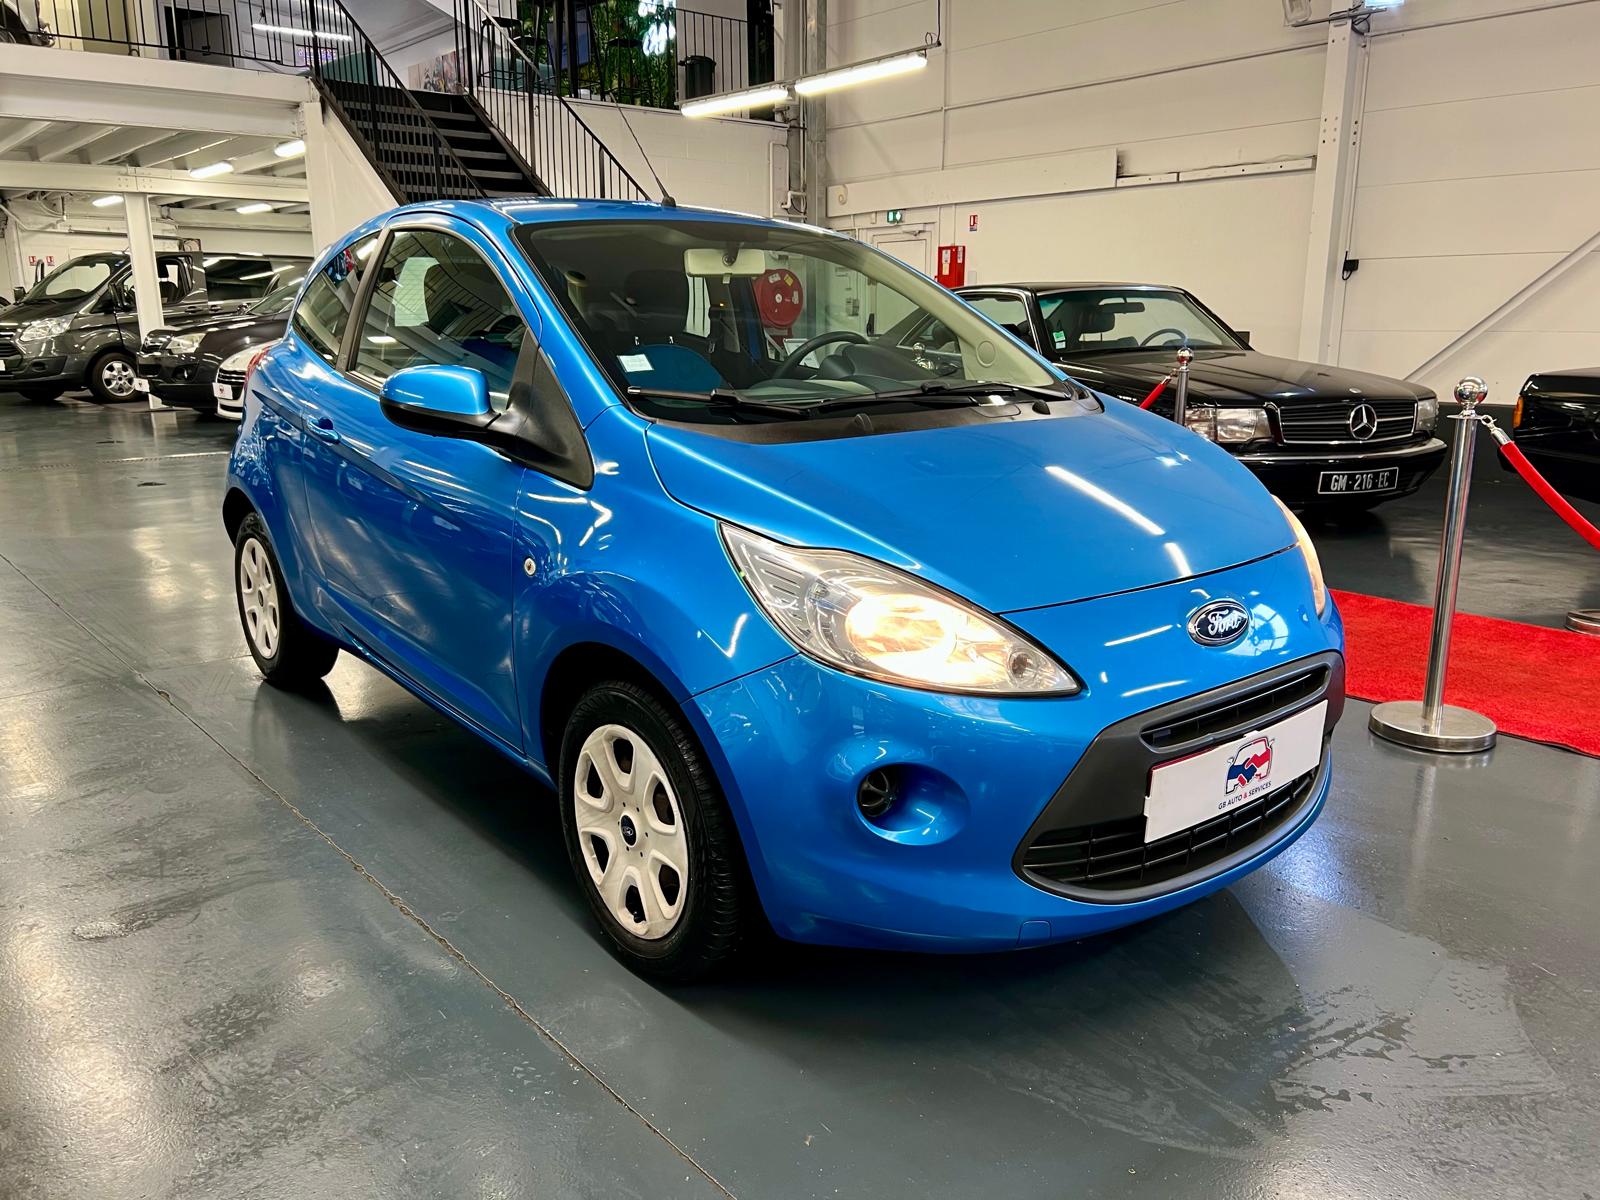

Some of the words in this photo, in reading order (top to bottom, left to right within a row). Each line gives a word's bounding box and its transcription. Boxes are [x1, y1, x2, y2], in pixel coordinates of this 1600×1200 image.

[1330, 475, 1348, 491] GM
[1353, 473, 1373, 490] 216
[1377, 471, 1390, 488] EC
[1207, 608, 1248, 636] Ford
[1218, 801, 1227, 810] GB
[1227, 794, 1243, 806] AUTO
[1248, 780, 1272, 797] SERVICES
